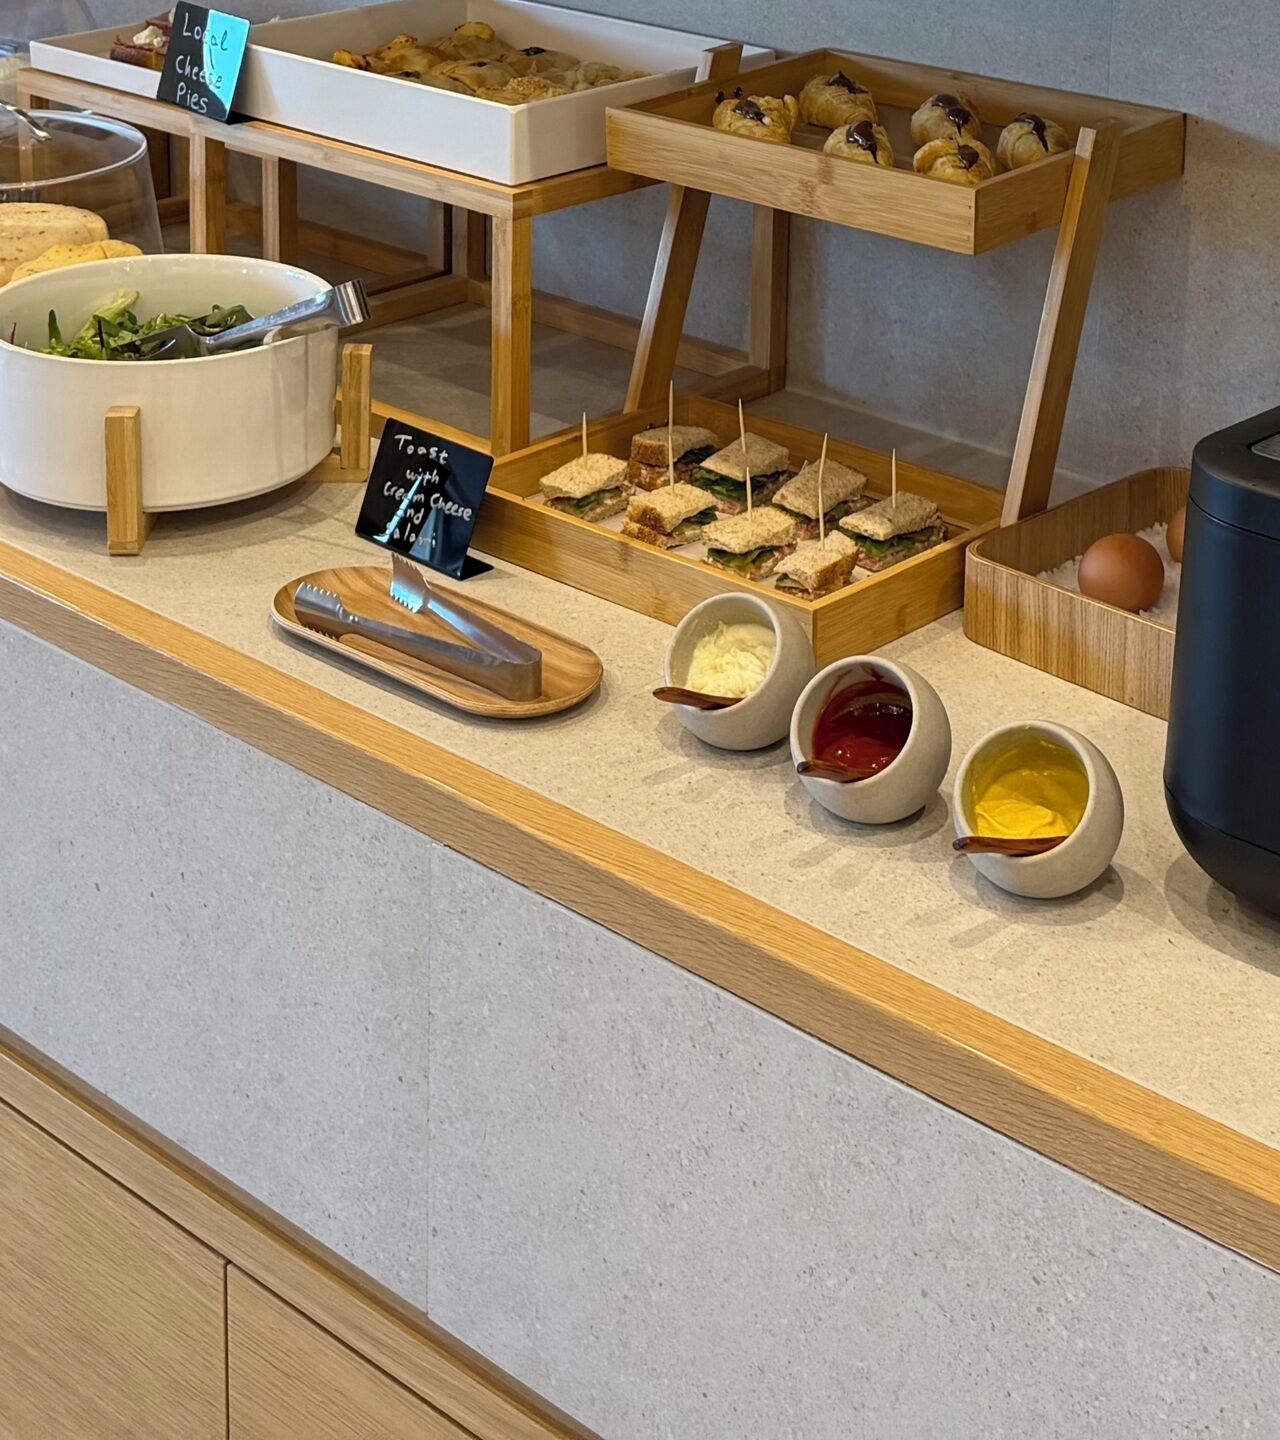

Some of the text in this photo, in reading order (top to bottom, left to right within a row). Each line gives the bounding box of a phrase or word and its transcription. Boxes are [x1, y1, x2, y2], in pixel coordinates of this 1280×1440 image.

[182, 12, 228, 51] Local
[175, 55, 223, 89] Cheese
[176, 81, 209, 113] Pies
[394, 434, 449, 465] Toast
[406, 468, 440, 487] with
[430, 492, 473, 522] Cheese
